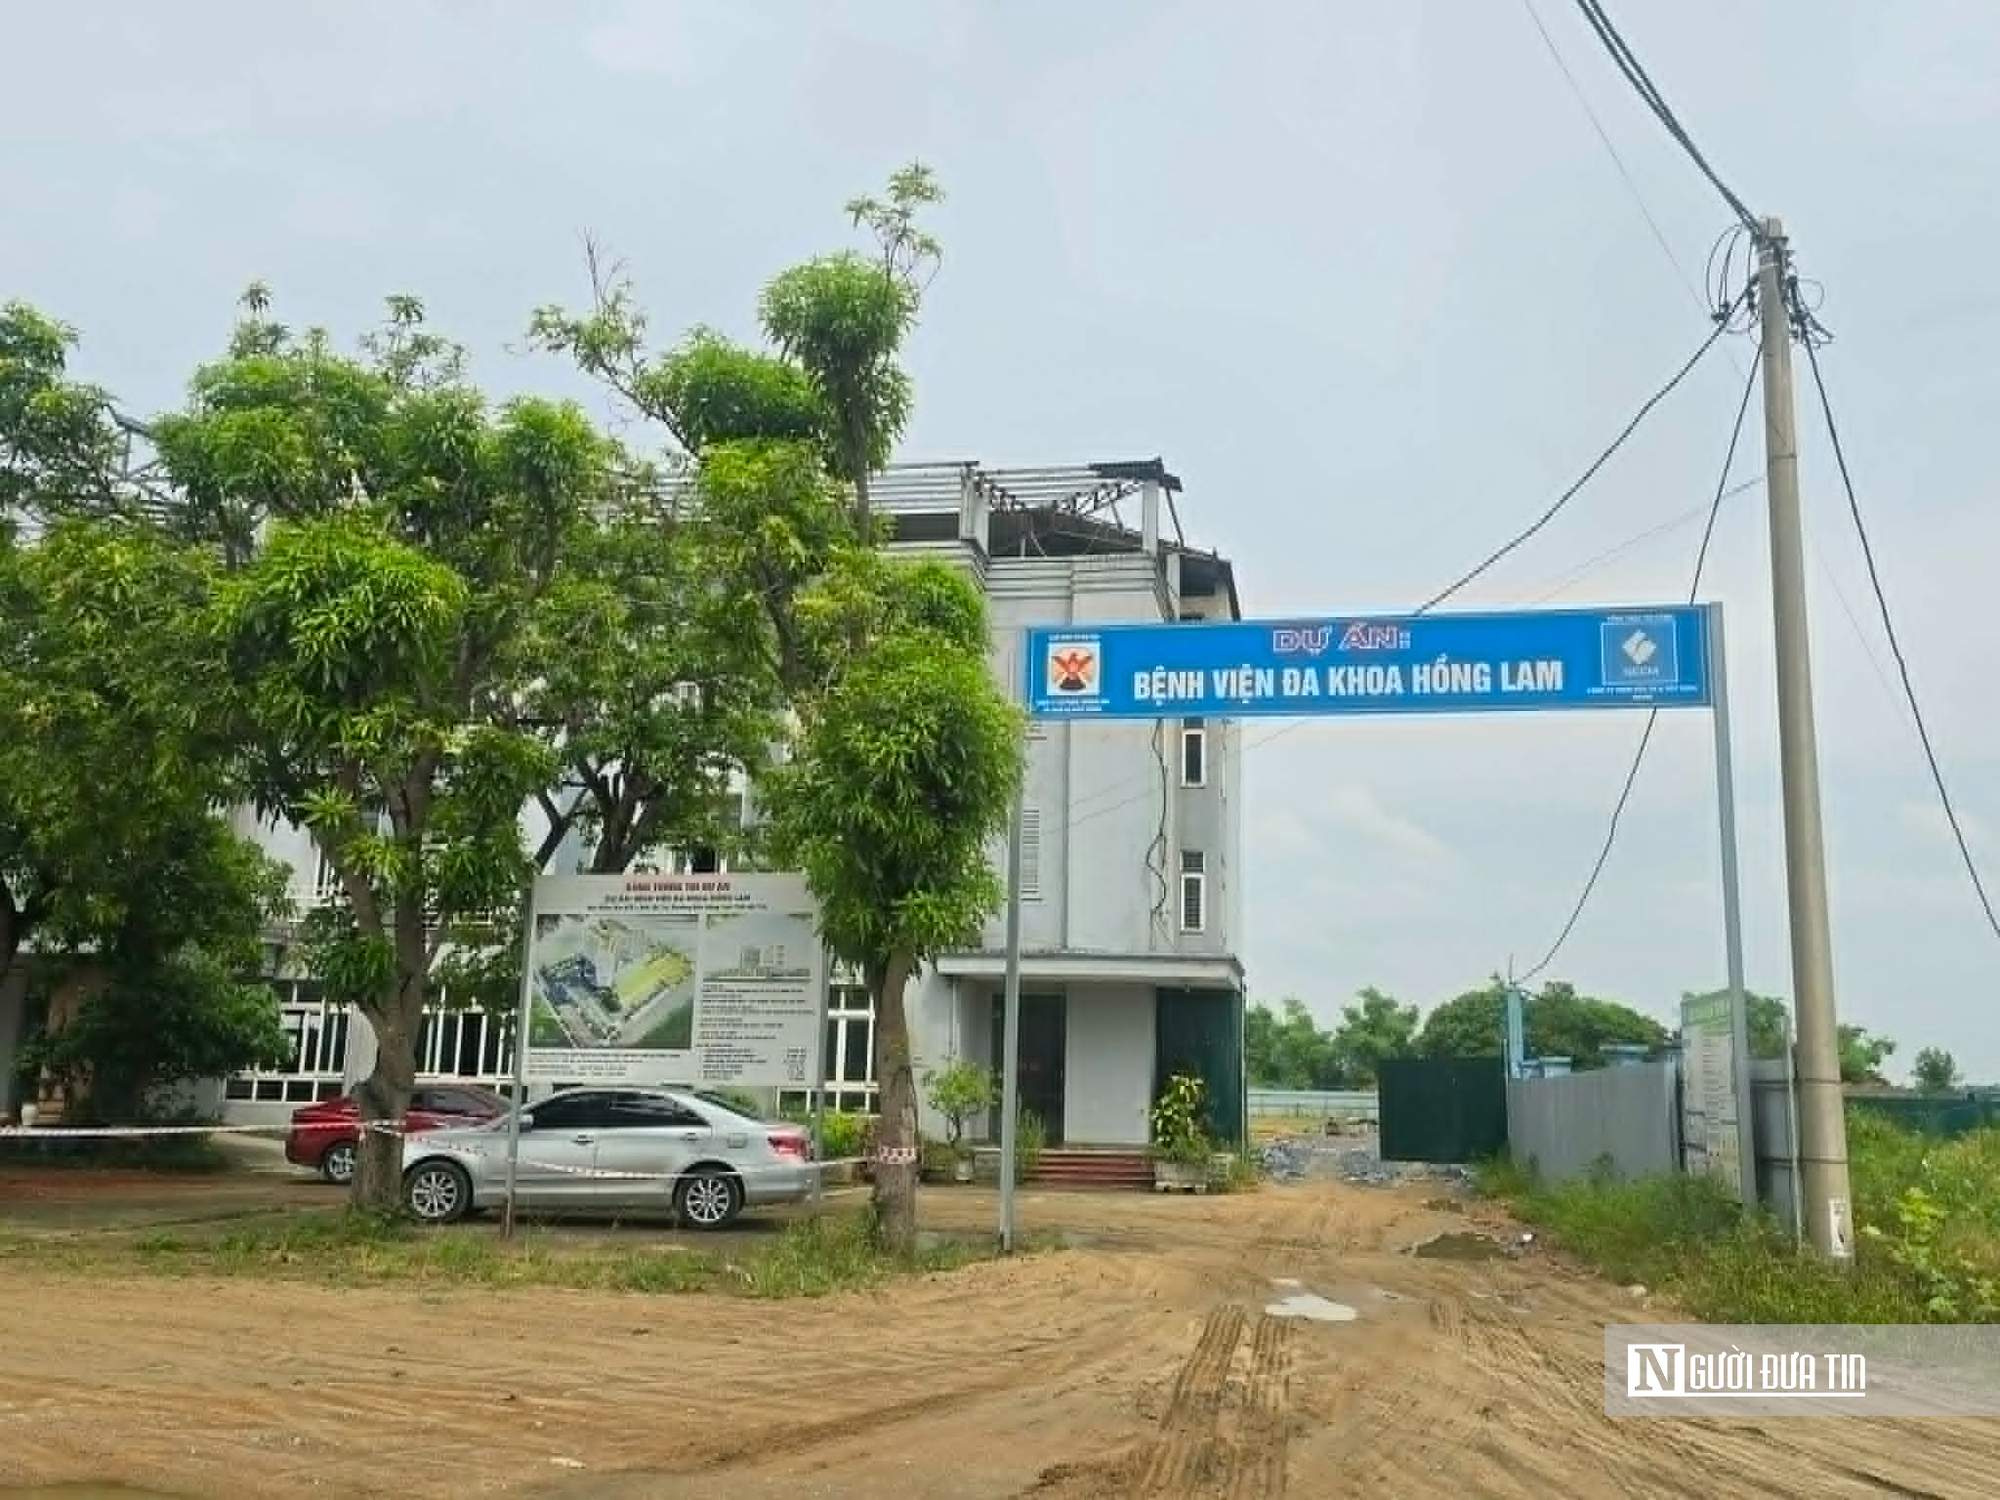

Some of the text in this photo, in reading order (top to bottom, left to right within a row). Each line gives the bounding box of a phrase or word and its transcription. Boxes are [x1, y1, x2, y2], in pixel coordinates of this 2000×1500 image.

[1272, 625, 1333, 656] DỰ
[1134, 665, 1205, 707] BỆNH
[1212, 664, 1275, 704] VIỆN
[1282, 665, 1320, 697] ĐA
[1328, 663, 1404, 697] KHOA
[1500, 661, 1563, 693] LAM
